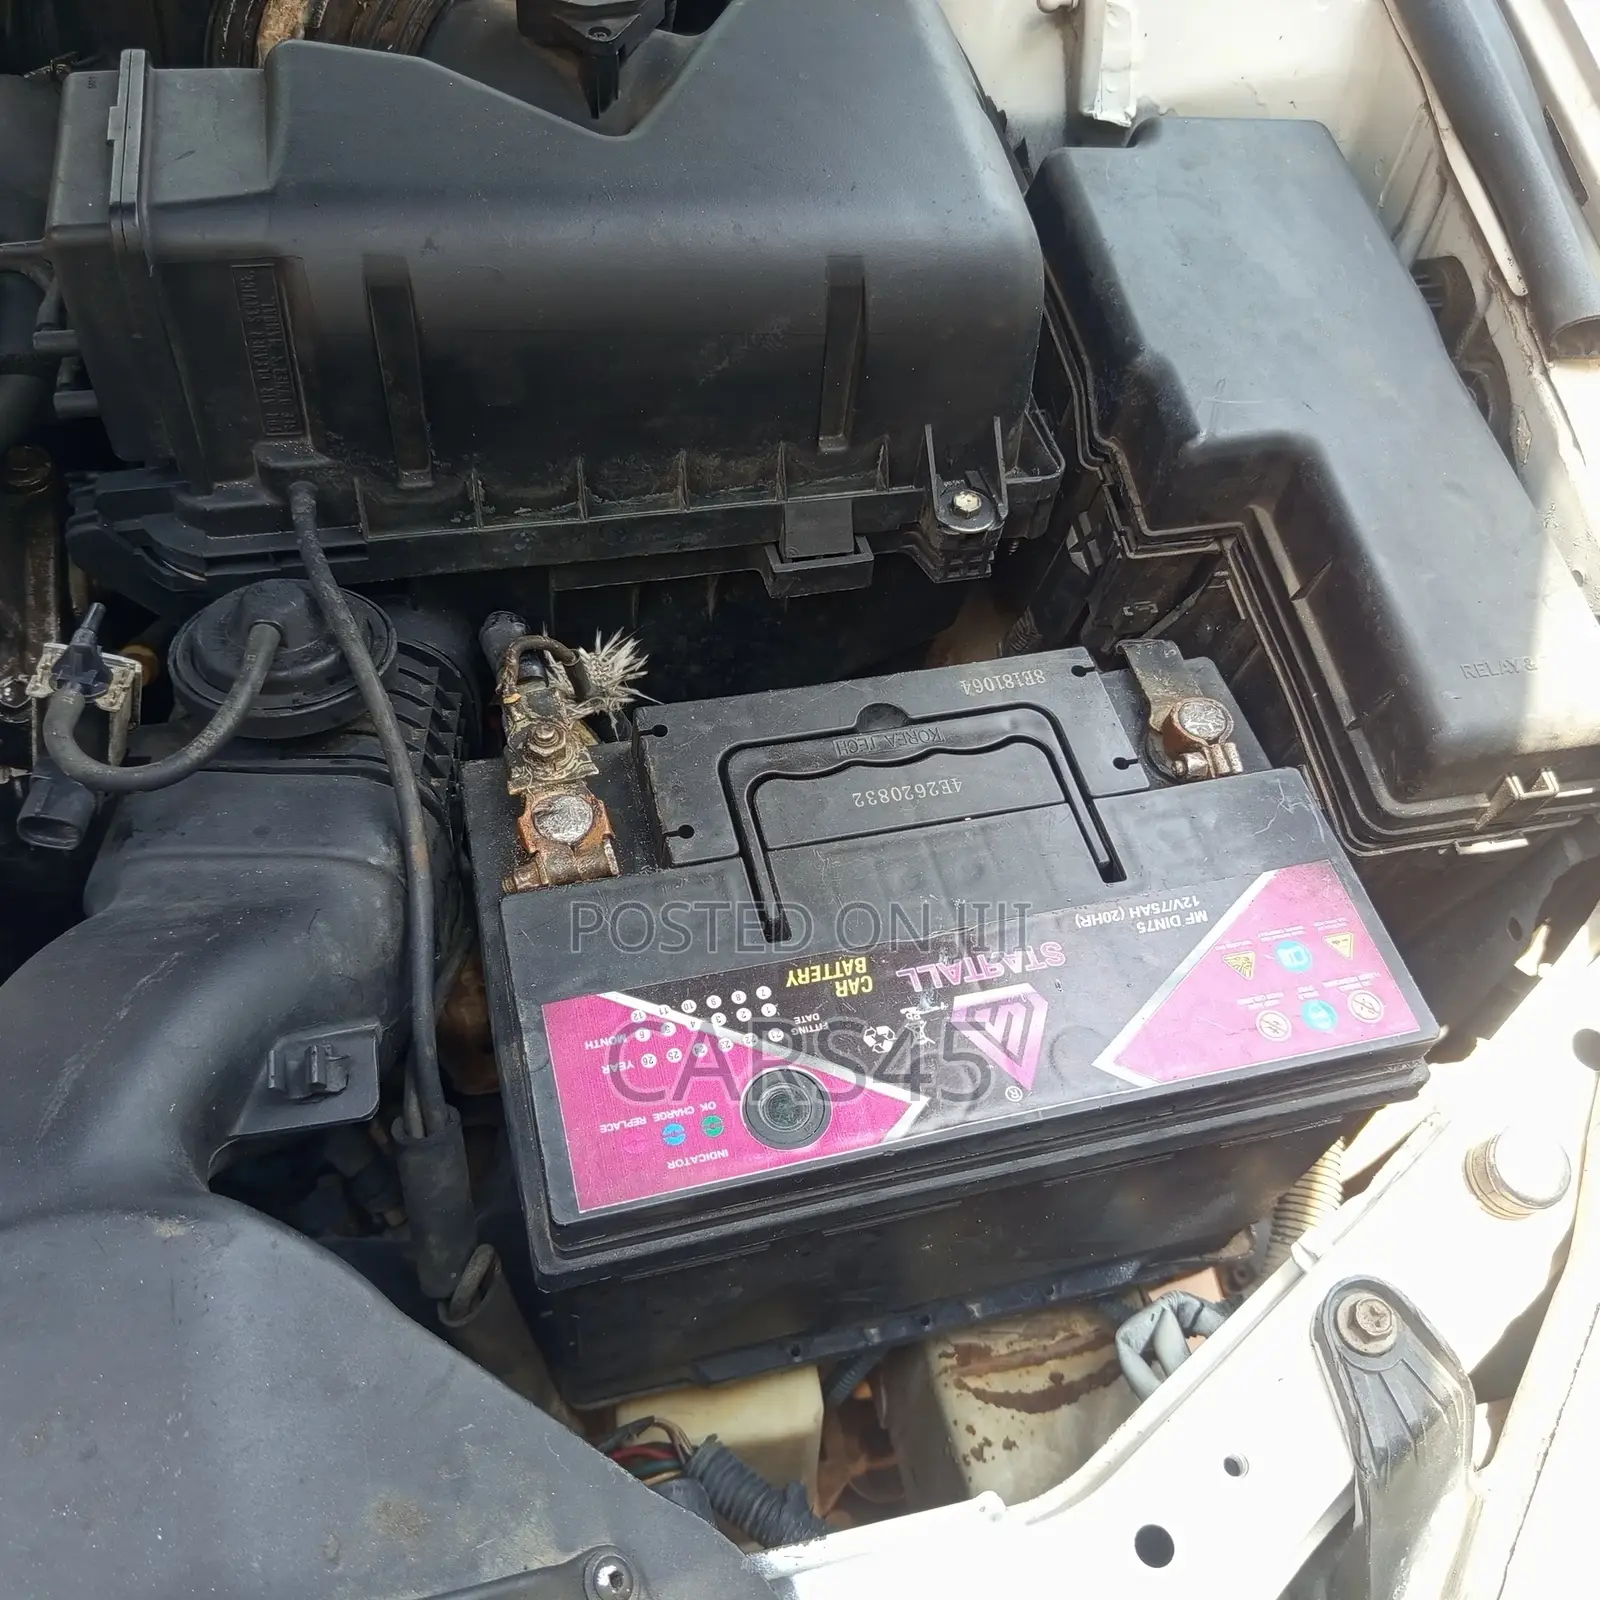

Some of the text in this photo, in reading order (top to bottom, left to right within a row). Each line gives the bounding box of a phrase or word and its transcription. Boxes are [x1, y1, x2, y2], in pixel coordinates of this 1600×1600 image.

[1460, 658, 1520, 680] RELAY
[959, 668, 1047, 696] 8E181064
[833, 727, 946, 758] KOREA TECH
[852, 777, 963, 807] 4E2620832
[1075, 894, 1200, 930] 12V/75AH (20HR)
[1136, 909, 1209, 934] MF DIN75
[785, 956, 868, 988] BATTERY
[835, 975, 873, 998] CAR
[633, 1011, 644, 1021] 12
[659, 1006, 669, 1015] 11
[683, 1001, 695, 1011] 10
[794, 1012, 820, 1024] DATE
[790, 1021, 829, 1036] FITTING
[585, 1034, 627, 1050] MONTH
[643, 1055, 654, 1065] 26
[668, 1050, 680, 1060] 25
[602, 1060, 635, 1075] YEAR
[600, 1101, 717, 1133] OK CHARGE REPLACE
[667, 1149, 729, 1169] INDICATOR
